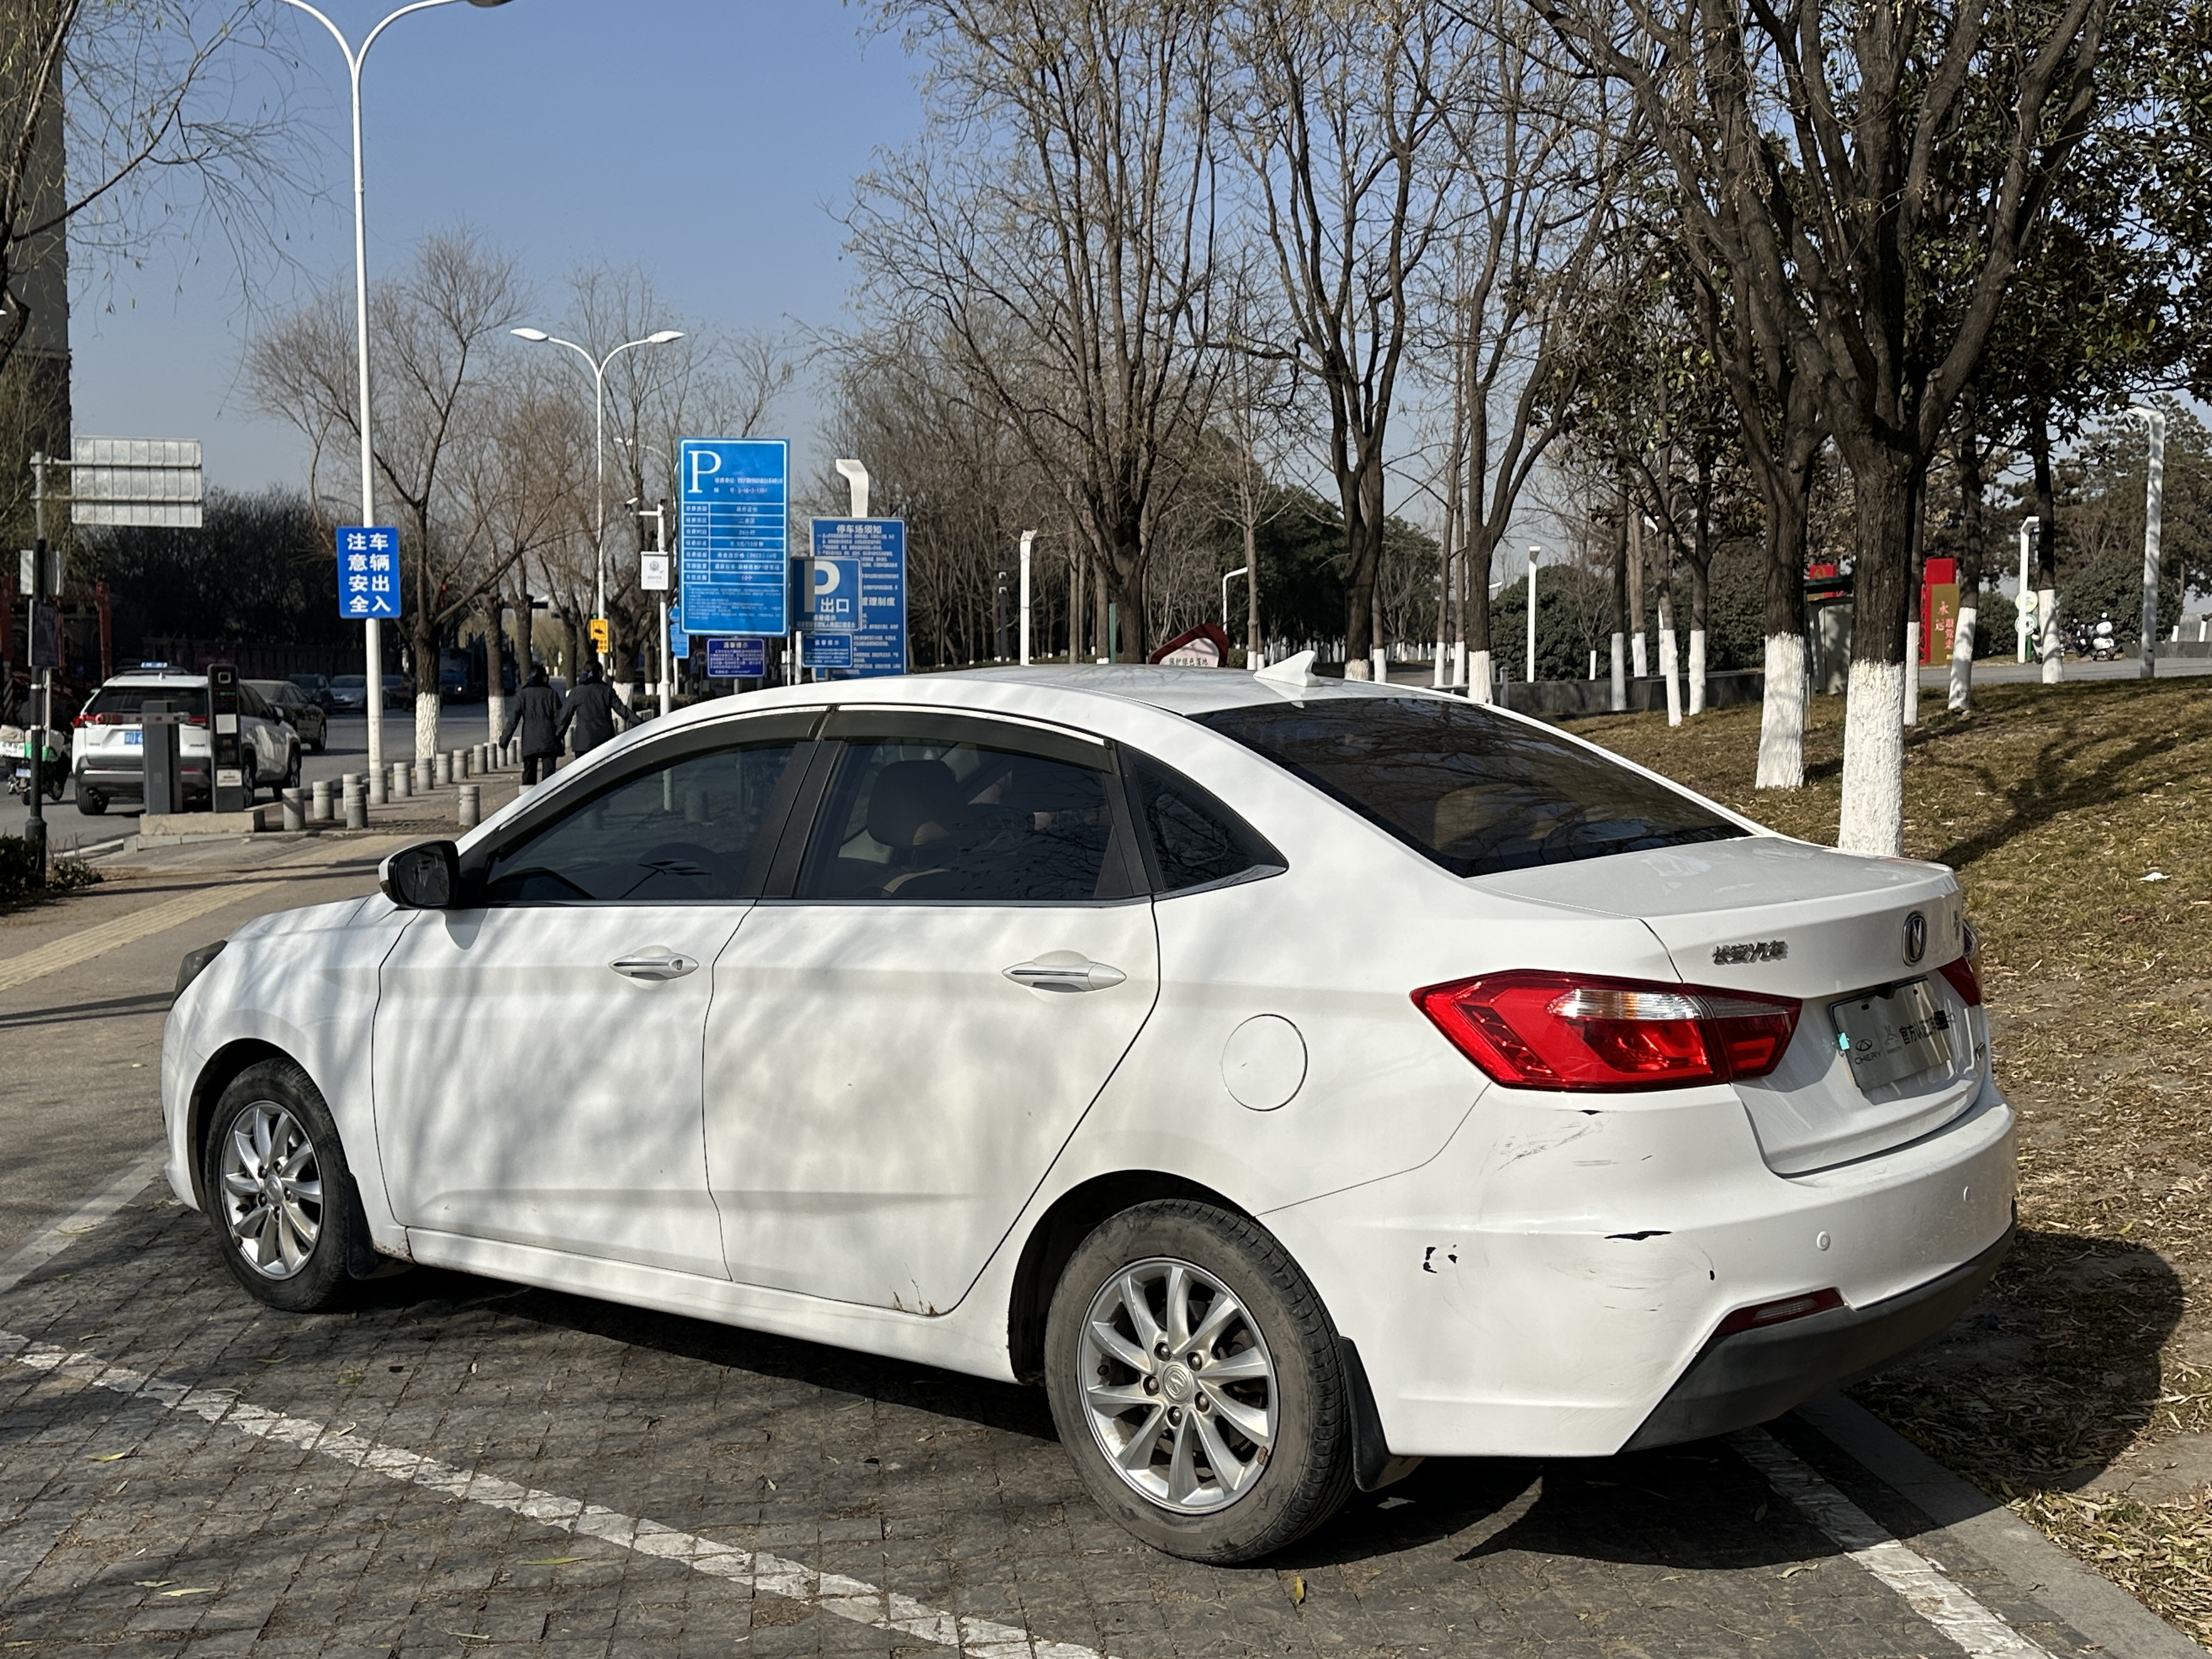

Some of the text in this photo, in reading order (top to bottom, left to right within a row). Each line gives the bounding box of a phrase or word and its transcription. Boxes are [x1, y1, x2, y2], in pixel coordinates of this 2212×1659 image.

[688, 450, 722, 493] P
[837, 524, 882, 534] 停车场须知
[347, 533, 369, 613] 注意安全
[369, 533, 391, 612] 车辆出入
[804, 561, 840, 612] P
[820, 597, 850, 613] 出口
[1712, 940, 1786, 964] 长安汽车
[1854, 1050, 1882, 1065] CHERY
